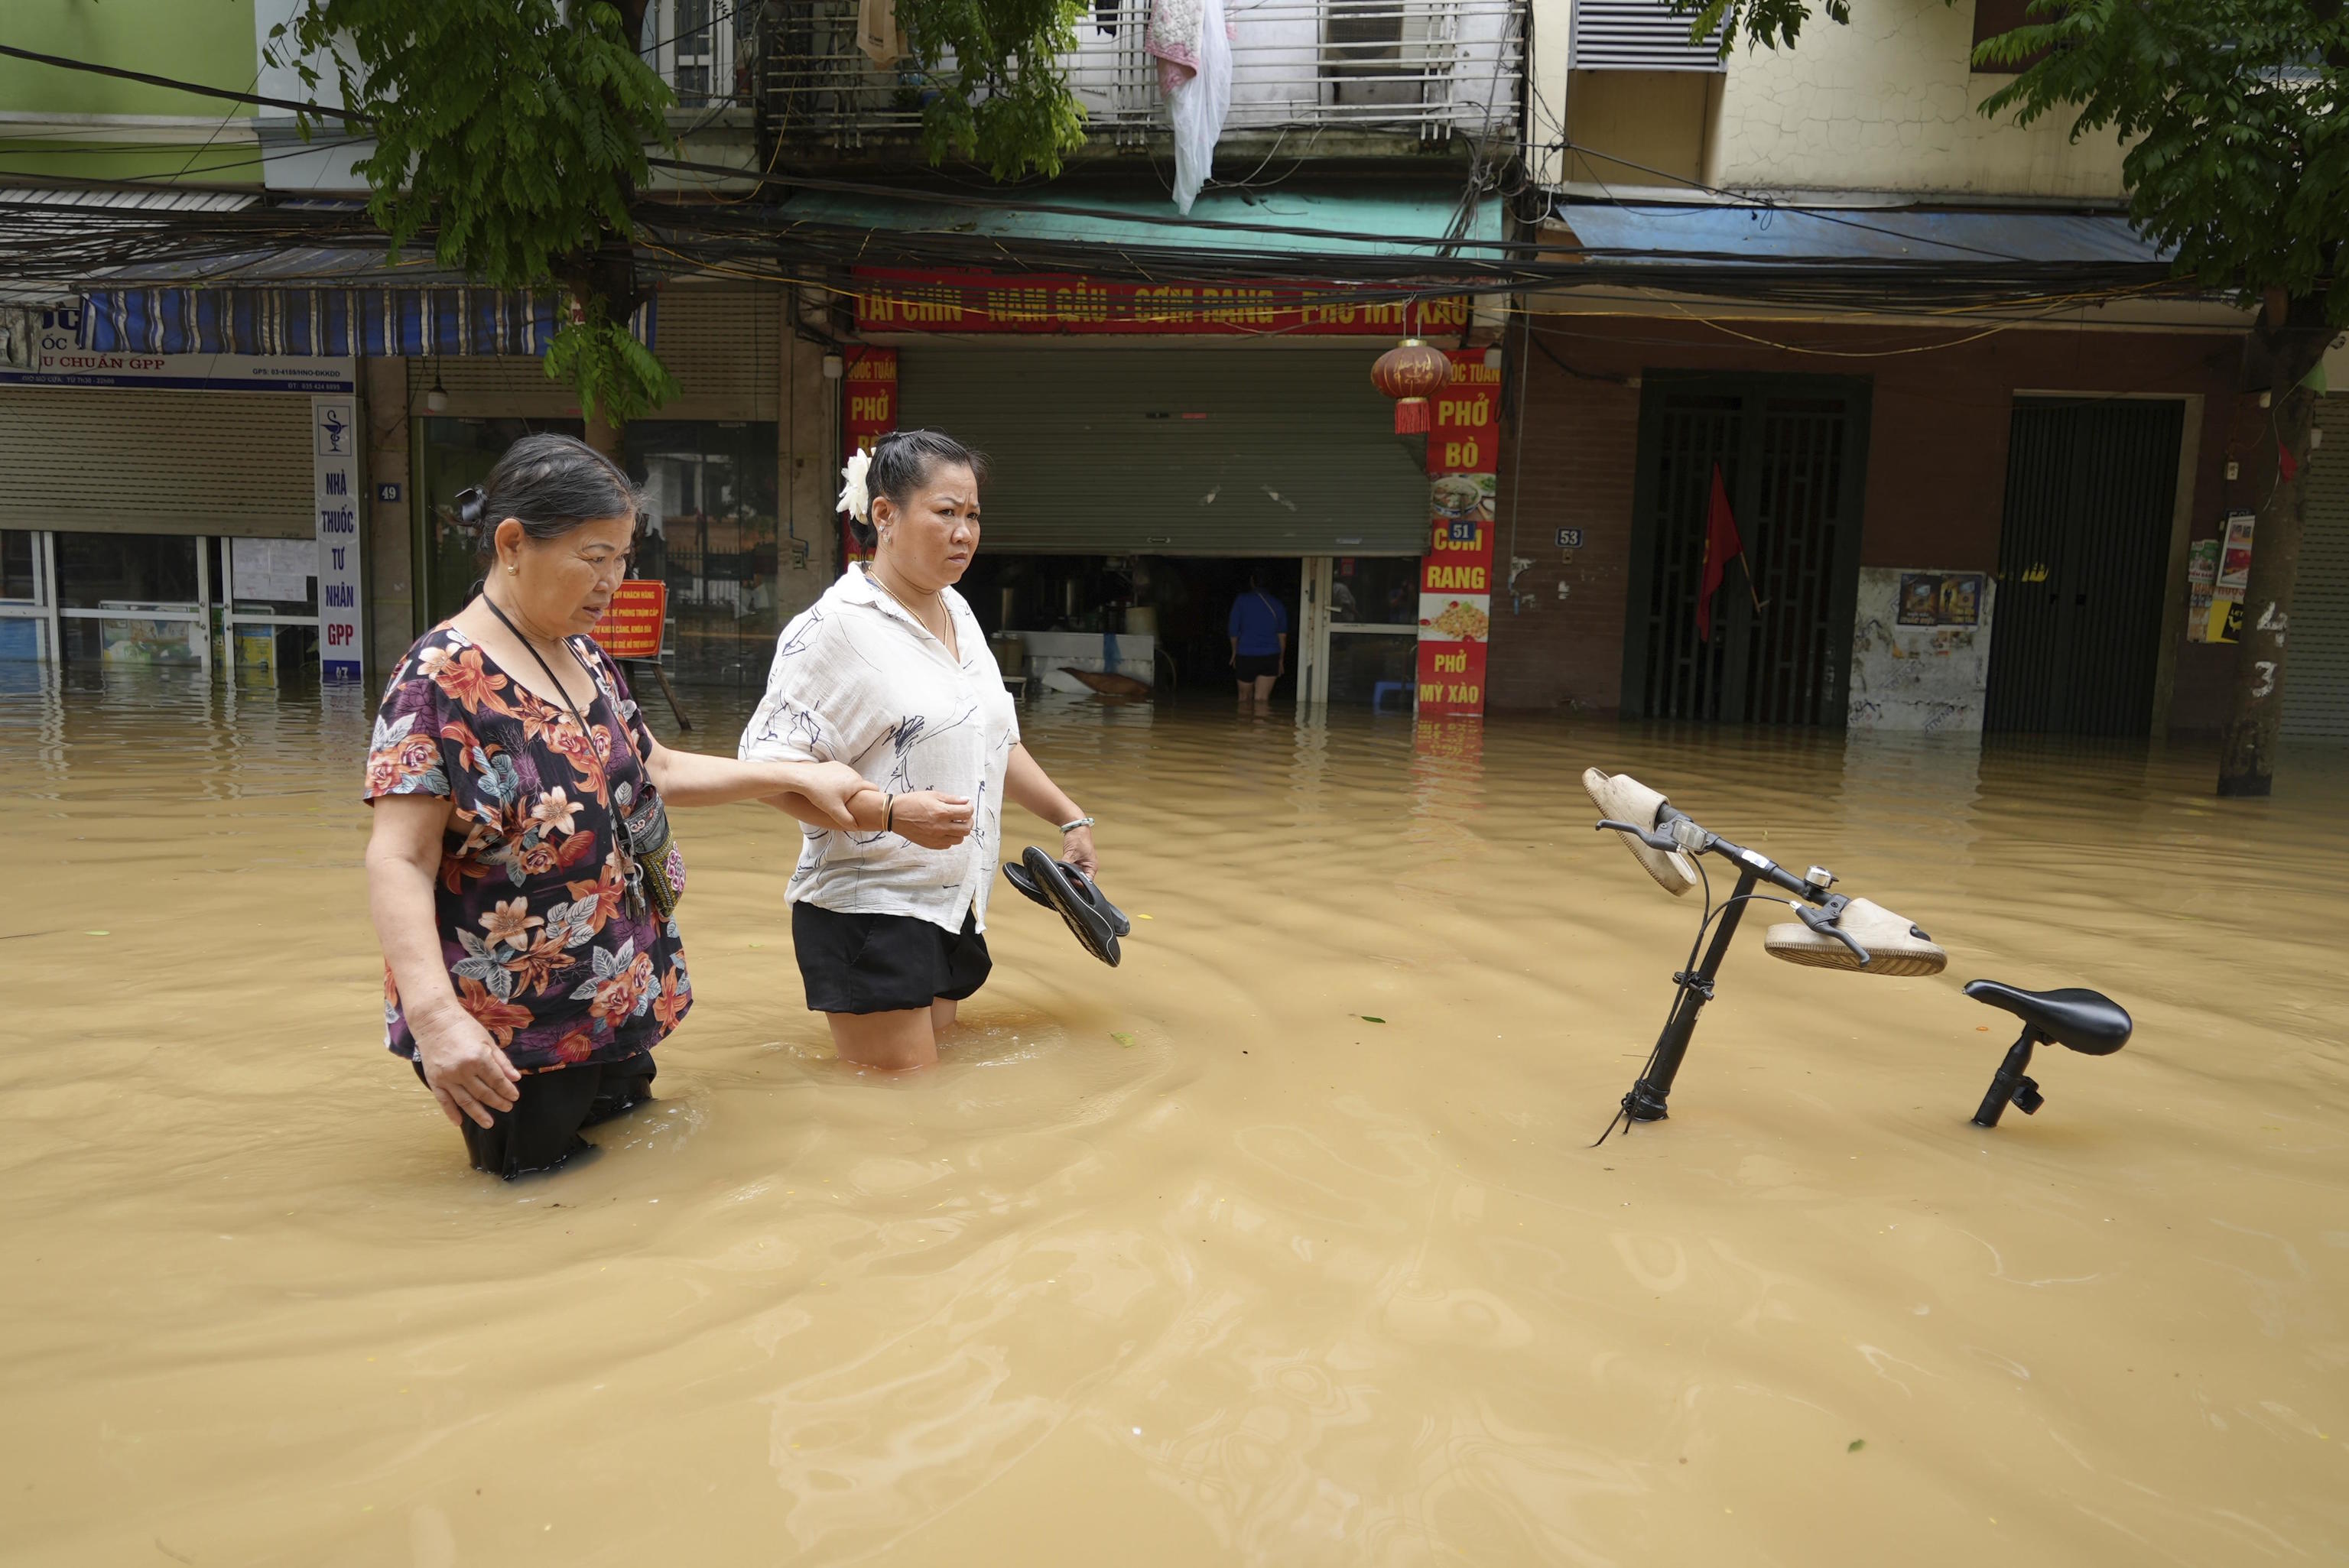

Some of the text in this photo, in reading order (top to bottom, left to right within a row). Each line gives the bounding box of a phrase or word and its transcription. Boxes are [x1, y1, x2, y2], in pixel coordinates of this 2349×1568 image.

[60, 353, 123, 368] CHUẨN
[129, 359, 165, 370] GPP
[851, 388, 889, 421] PHỞ
[1438, 391, 1490, 427] PHỞ
[1444, 437, 1479, 468] BÒ
[326, 470, 347, 495] NHÀ
[382, 485, 396, 499] 49
[321, 504, 354, 533] THUỐC
[1453, 524, 1469, 539] 51
[1560, 530, 1579, 545] 53
[332, 546, 345, 570] TƯ
[1427, 565, 1486, 589] RANG
[326, 582, 354, 608] NHÂN
[327, 623, 354, 646] GPP
[1434, 649, 1467, 673] PHỞ
[2251, 660, 2277, 697] 3
[1419, 681, 1480, 704] MỲ XÀO
